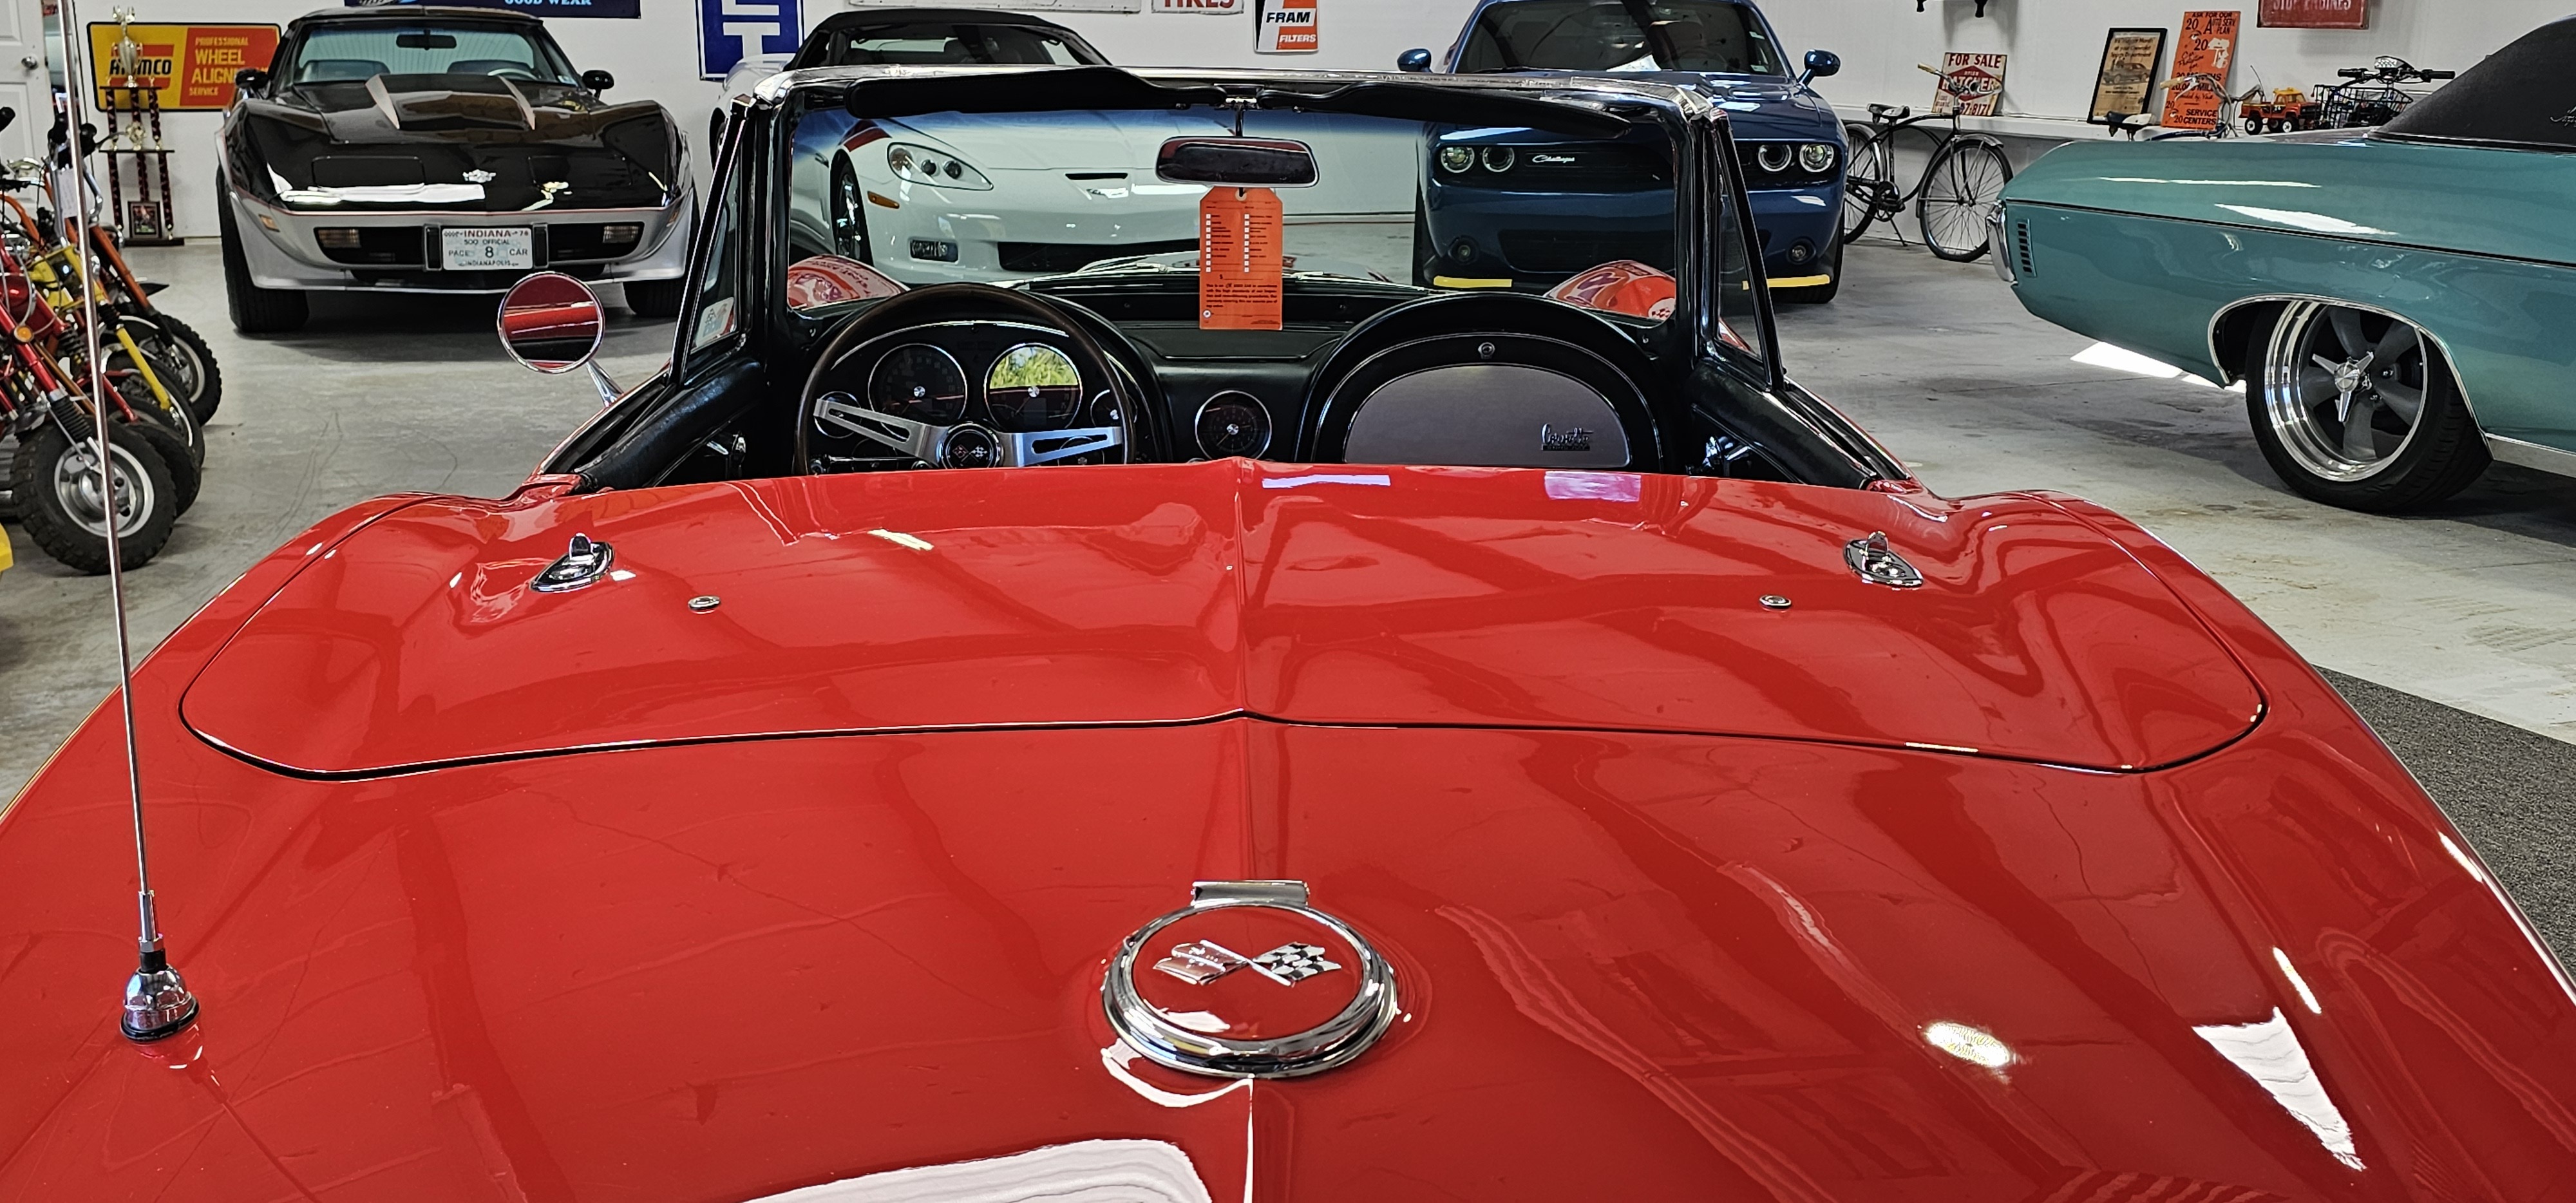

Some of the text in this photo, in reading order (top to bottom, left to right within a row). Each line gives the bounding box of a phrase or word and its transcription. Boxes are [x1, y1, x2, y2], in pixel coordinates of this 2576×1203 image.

[1266, 12, 1311, 23] FRAM
[2185, 18, 2199, 30] 20
[195, 37, 249, 46] PROFESSIONAL
[1279, 34, 1316, 43] FILTERS
[2194, 39, 2209, 51] 20
[195, 48, 245, 65] WHEEL
[1949, 53, 2002, 68] FOR SALE
[109, 59, 172, 75] AMCO
[189, 88, 218, 96] SERVICE
[2186, 109, 2218, 117] SERVICE
[2183, 117, 2217, 125] CENTERS
[485, 246, 493, 258] 8
